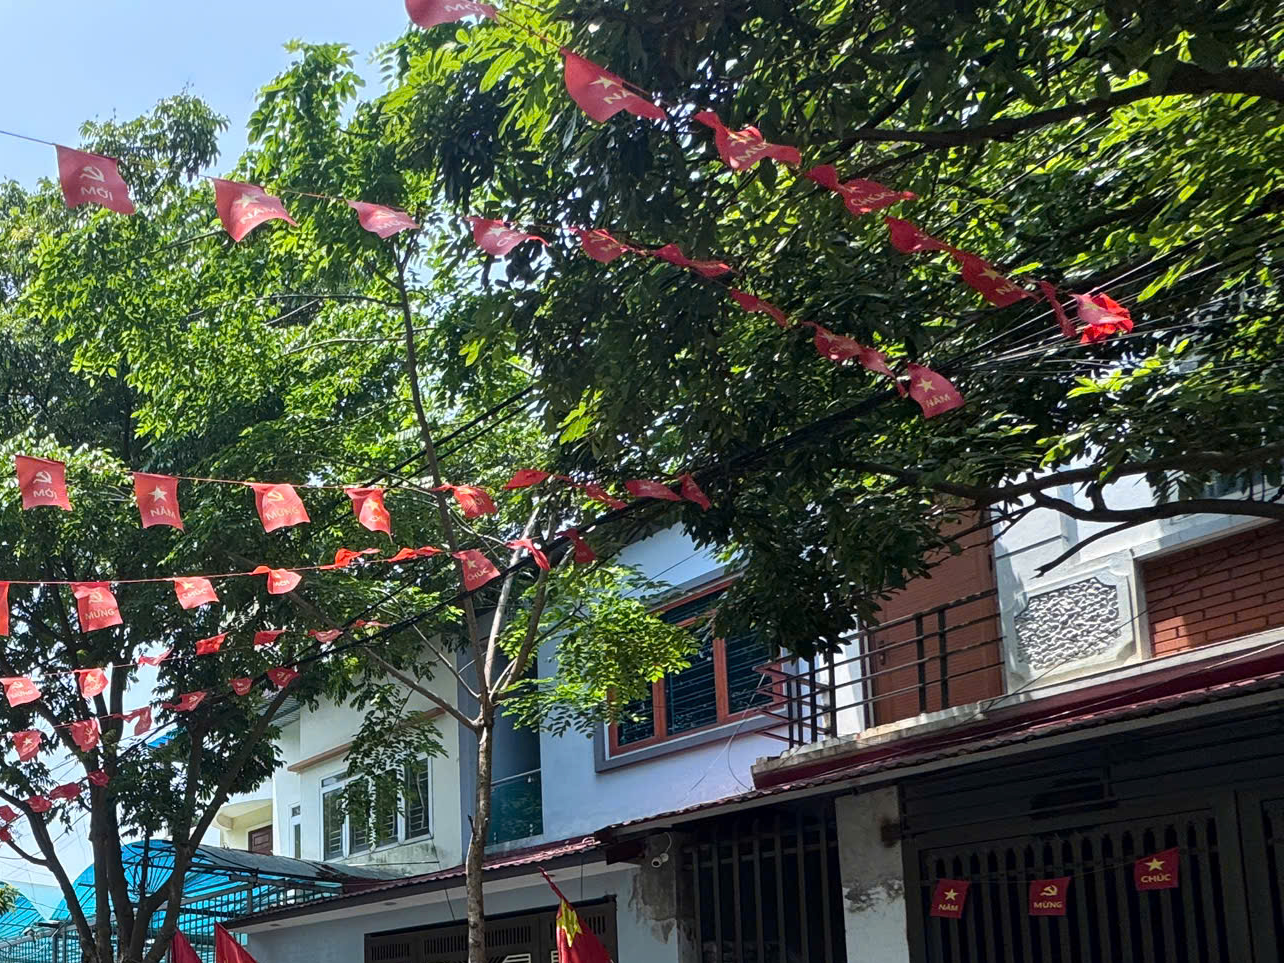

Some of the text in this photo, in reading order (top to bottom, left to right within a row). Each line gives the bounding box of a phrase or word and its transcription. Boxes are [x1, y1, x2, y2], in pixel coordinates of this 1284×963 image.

[81, 185, 114, 202] MỚI
[33, 487, 58, 500] MỚI
[150, 506, 176, 520] NĂM
[1141, 873, 1172, 884] CHÚC
[938, 902, 959, 912] NĂM
[1033, 900, 1063, 909] MỪNG
